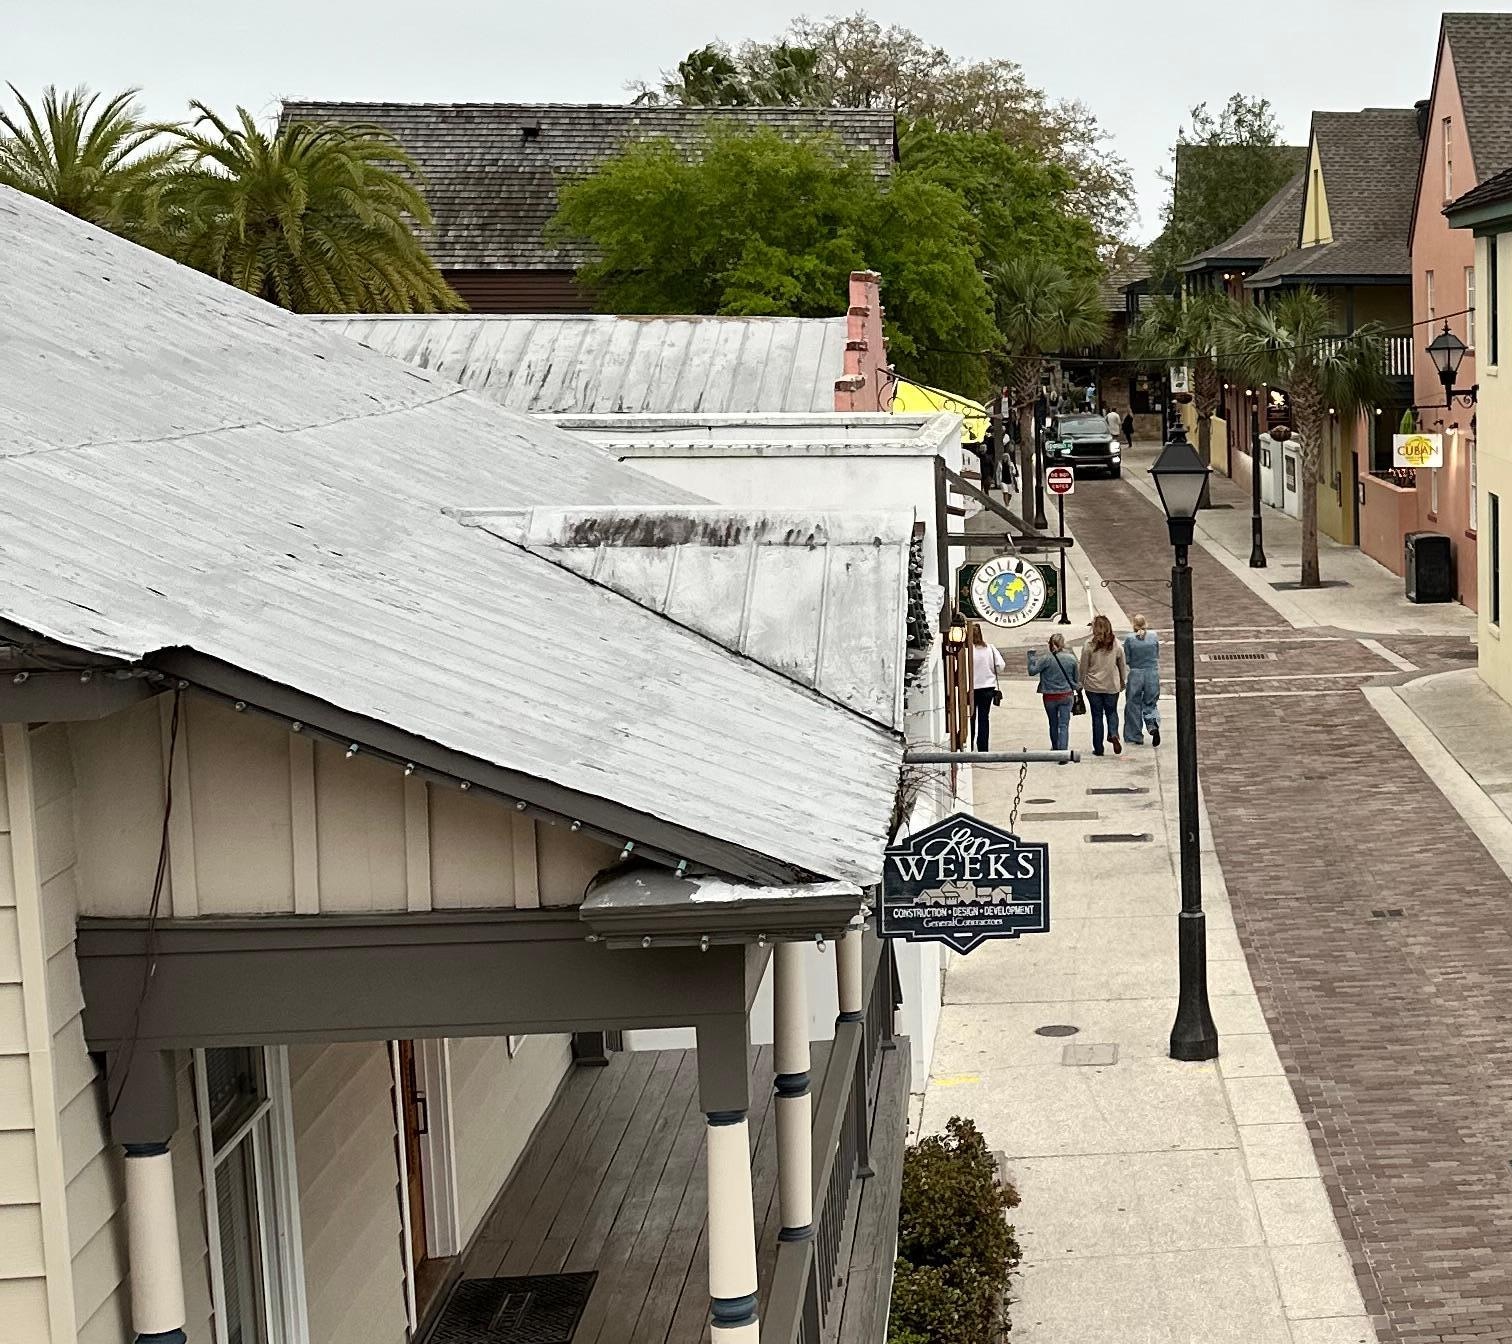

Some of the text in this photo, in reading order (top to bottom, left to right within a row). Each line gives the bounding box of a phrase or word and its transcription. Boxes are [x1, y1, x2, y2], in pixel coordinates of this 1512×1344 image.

[1397, 445, 1438, 456] CUBAN
[977, 559, 1041, 585] COLLGE
[921, 827, 1009, 862] Len
[891, 853, 1035, 881] WEEKS
[893, 905, 1034, 918] CONSTRUCTION DESIGN DEVELOPMENT
